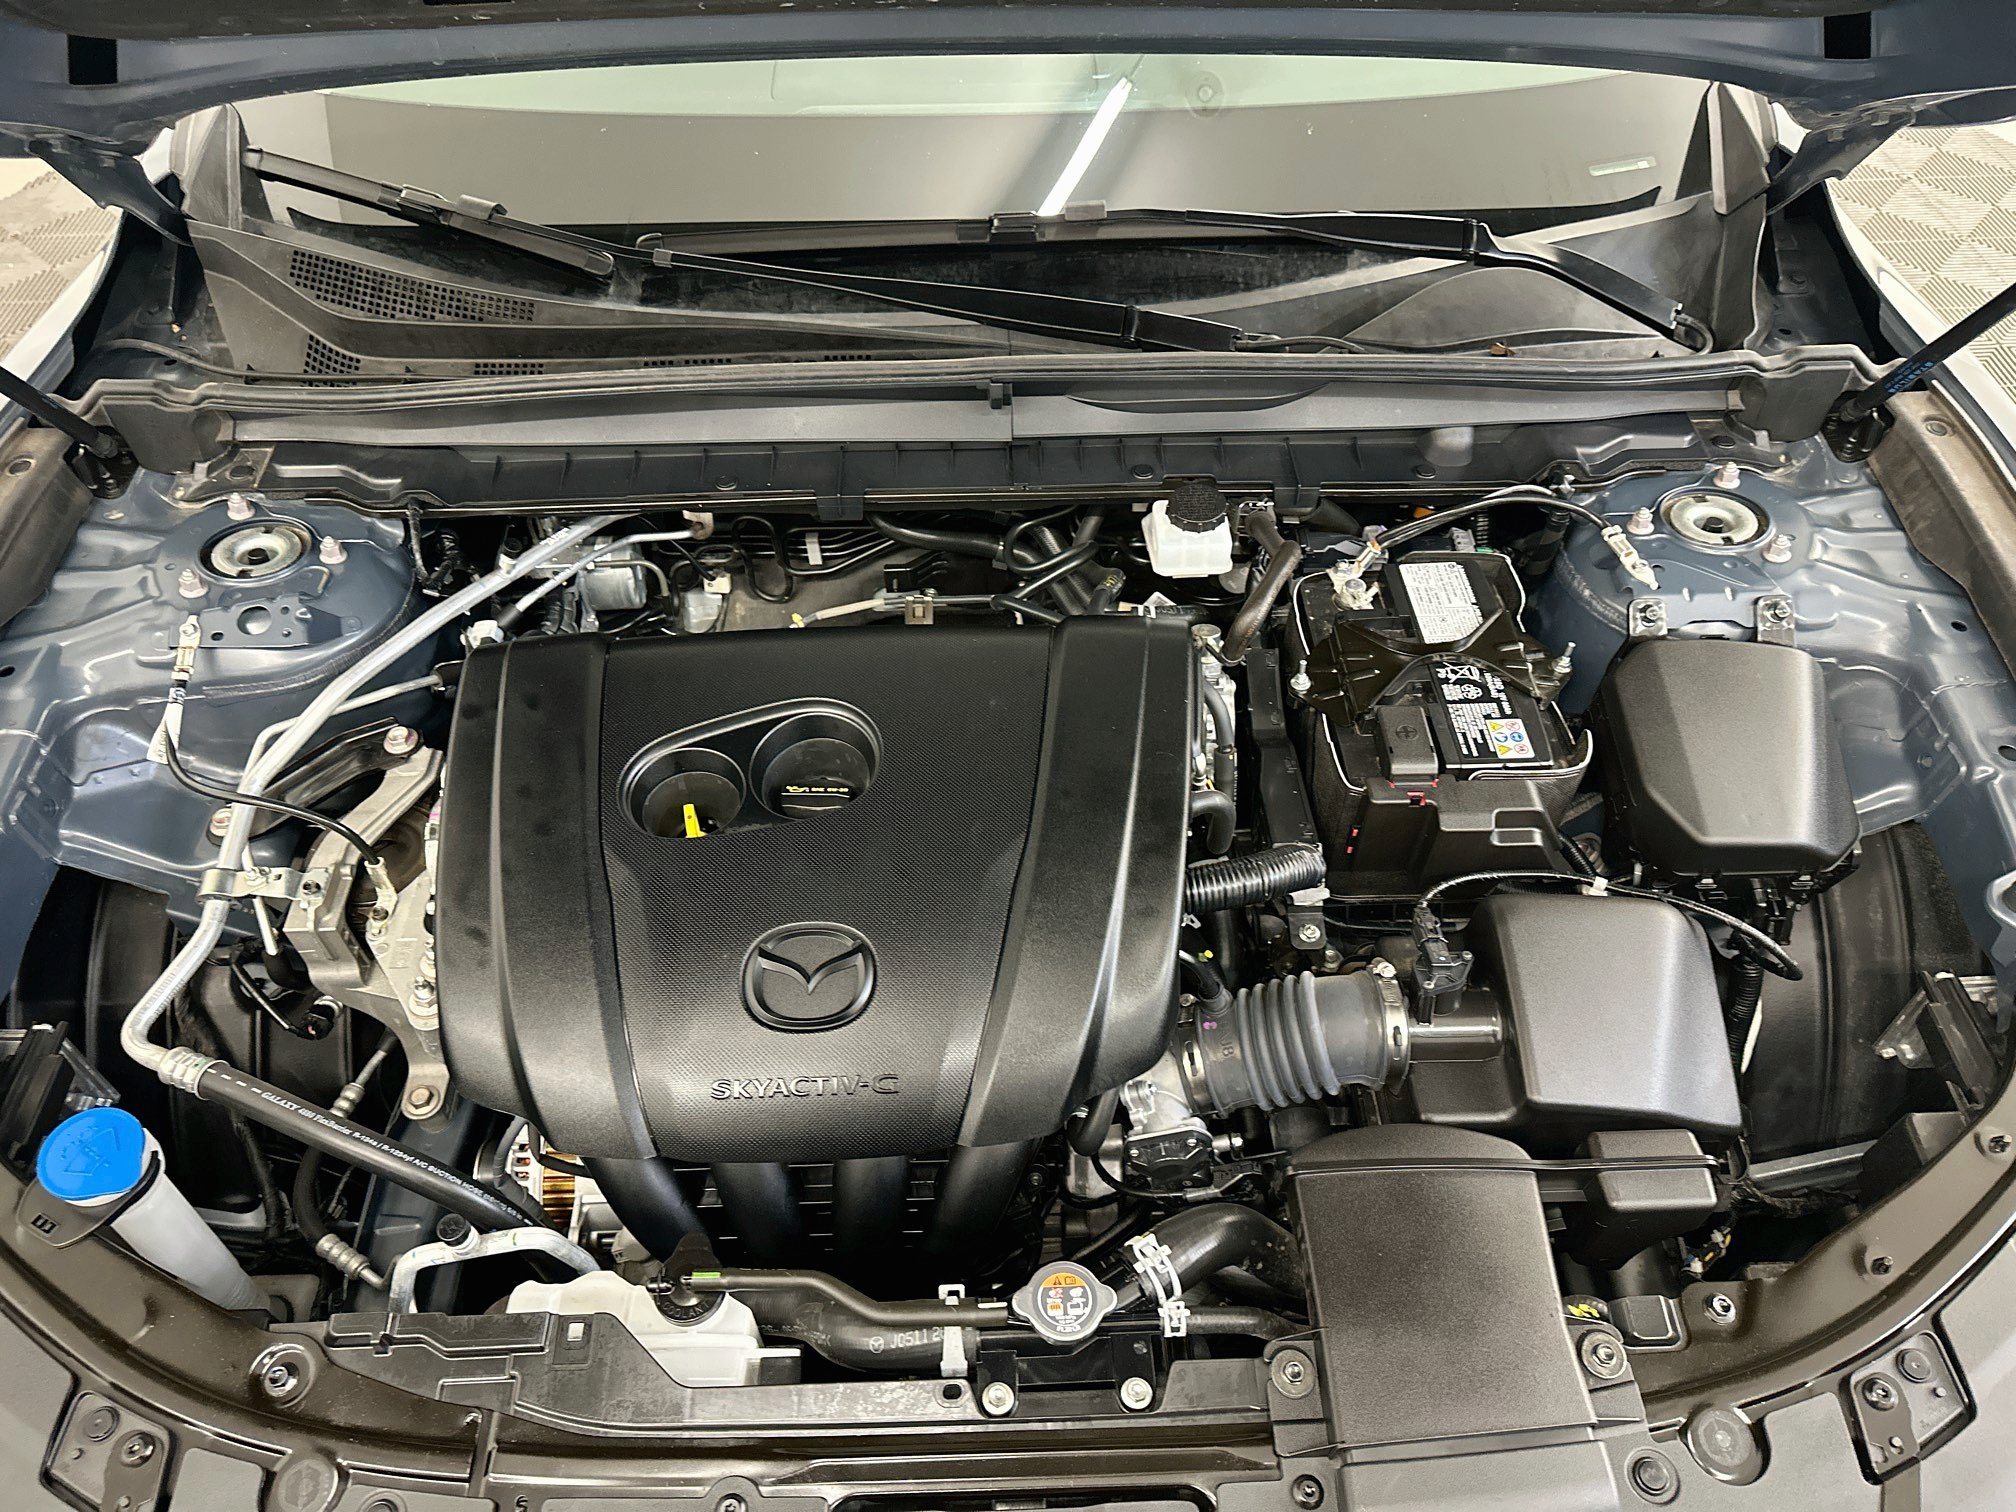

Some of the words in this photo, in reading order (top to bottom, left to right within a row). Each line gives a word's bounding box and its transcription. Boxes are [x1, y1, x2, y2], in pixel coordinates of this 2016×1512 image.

[711, 1073, 899, 1099] SKYACTIV-G
[261, 1091, 302, 1113] GALAXY
[426, 1163, 464, 1186] SUCTION
[461, 1179, 484, 1196] HOSE
[662, 1300, 711, 1319] COOLANT
